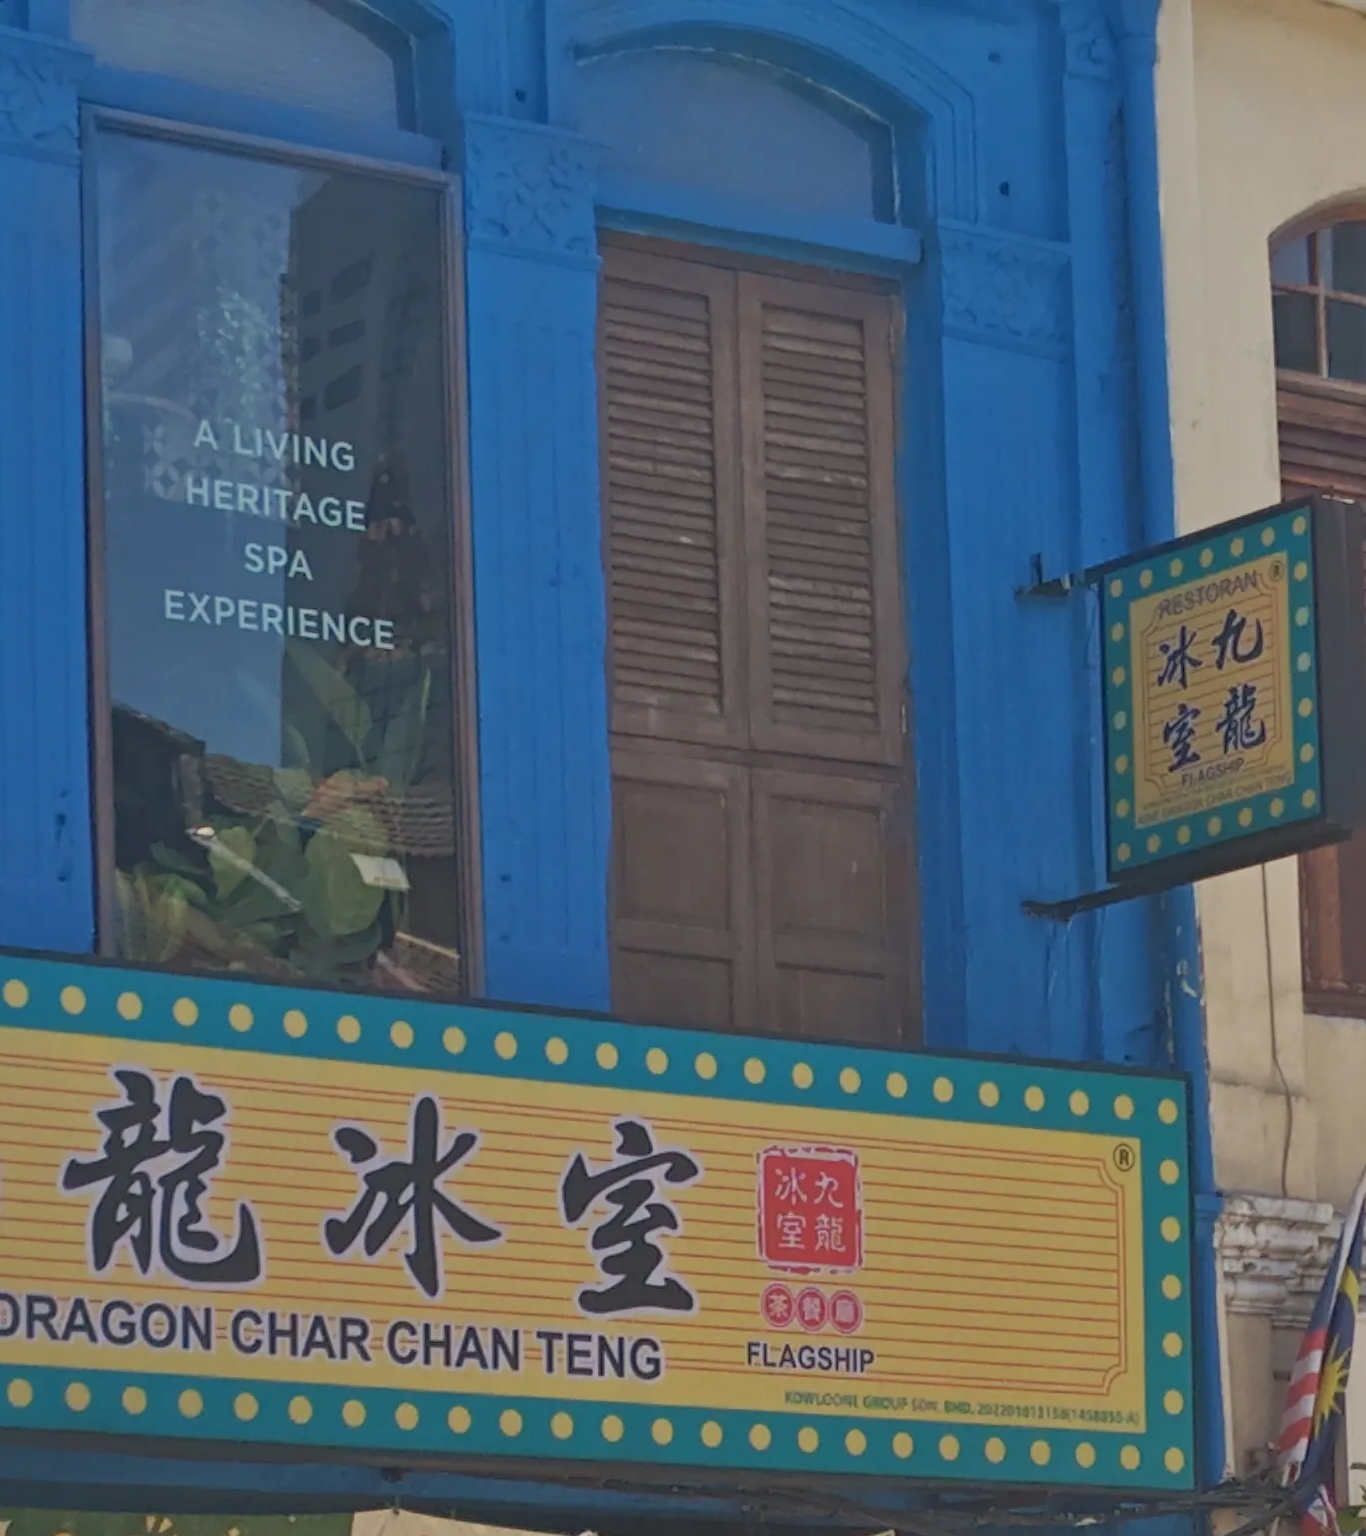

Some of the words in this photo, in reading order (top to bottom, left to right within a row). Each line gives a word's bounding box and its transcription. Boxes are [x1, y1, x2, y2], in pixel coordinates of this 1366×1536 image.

[194, 420, 218, 450] A
[235, 425, 355, 470] LIVING
[187, 476, 366, 531] HERITAGE
[245, 543, 313, 580] SPA
[1159, 569, 1258, 618] RESTORAN
[164, 590, 395, 650] EXPERIENCE
[231, 1307, 371, 1365] CHAR
[386, 1319, 521, 1372] CHAN
[536, 1330, 662, 1380] TENG
[747, 1341, 874, 1373] FLAGSHIP
[863, 1395, 908, 1412] GROUP
